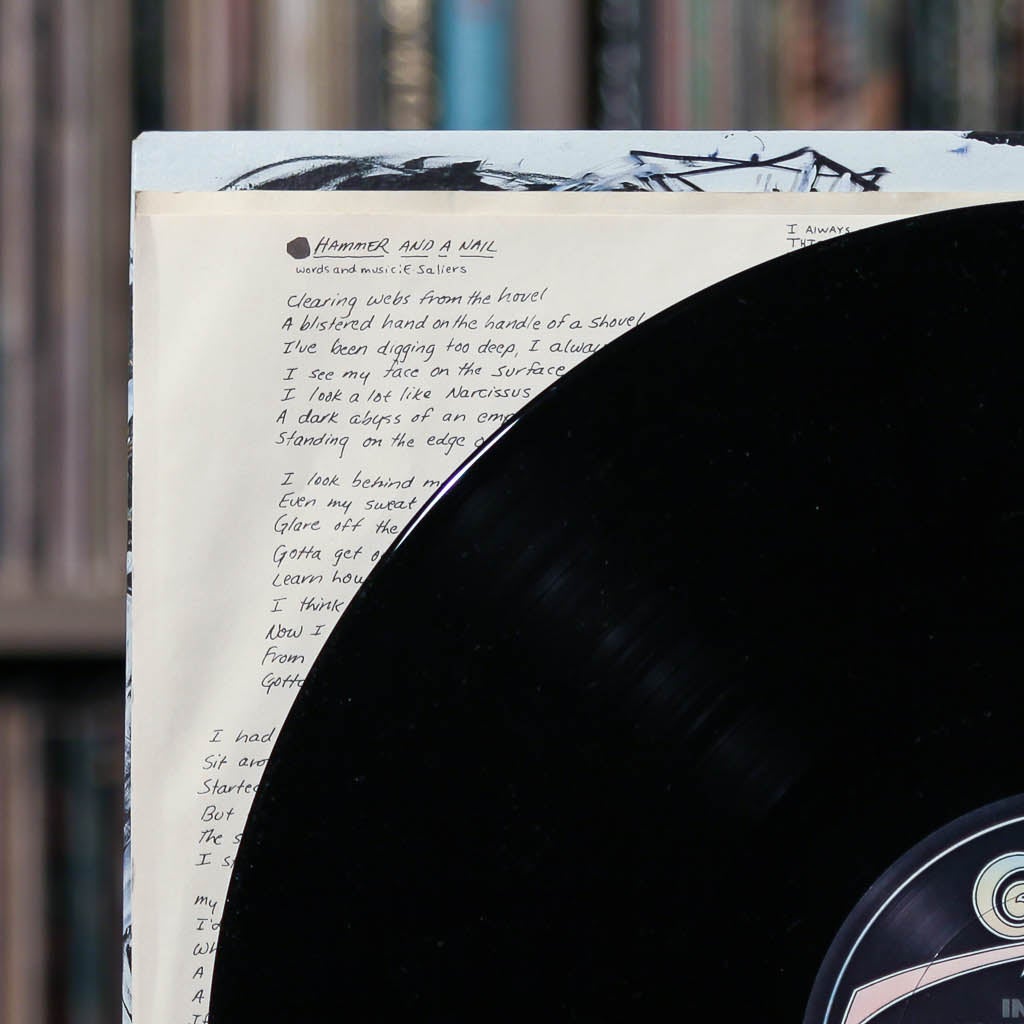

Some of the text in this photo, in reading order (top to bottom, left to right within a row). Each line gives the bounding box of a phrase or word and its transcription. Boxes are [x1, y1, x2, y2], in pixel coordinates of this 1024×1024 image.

[786, 224, 797, 234] I
[399, 240, 434, 252] AND
[440, 240, 450, 252] A
[459, 240, 497, 253] NAIL
[296, 264, 329, 274] words
[333, 264, 357, 274] and
[417, 264, 467, 275] Saliers
[366, 291, 411, 306] webs
[419, 291, 462, 304] from
[467, 291, 491, 305] the
[498, 287, 548, 302] hovel
[282, 317, 293, 331] A
[300, 313, 374, 331] blistered
[382, 313, 427, 330] hand
[433, 319, 449, 329] on
[452, 314, 477, 329] the
[485, 314, 541, 330] handle
[547, 314, 570, 329] of
[569, 320, 582, 329] a
[283, 338, 540, 365] I've been digging too deep, I
[283, 357, 566, 385] I see my face on the surface
[281, 385, 531, 403] I look a lot like Narcissus
[279, 492, 417, 515] Even my sweat
[271, 597, 344, 612] I think
[209, 728, 276, 743] I had
